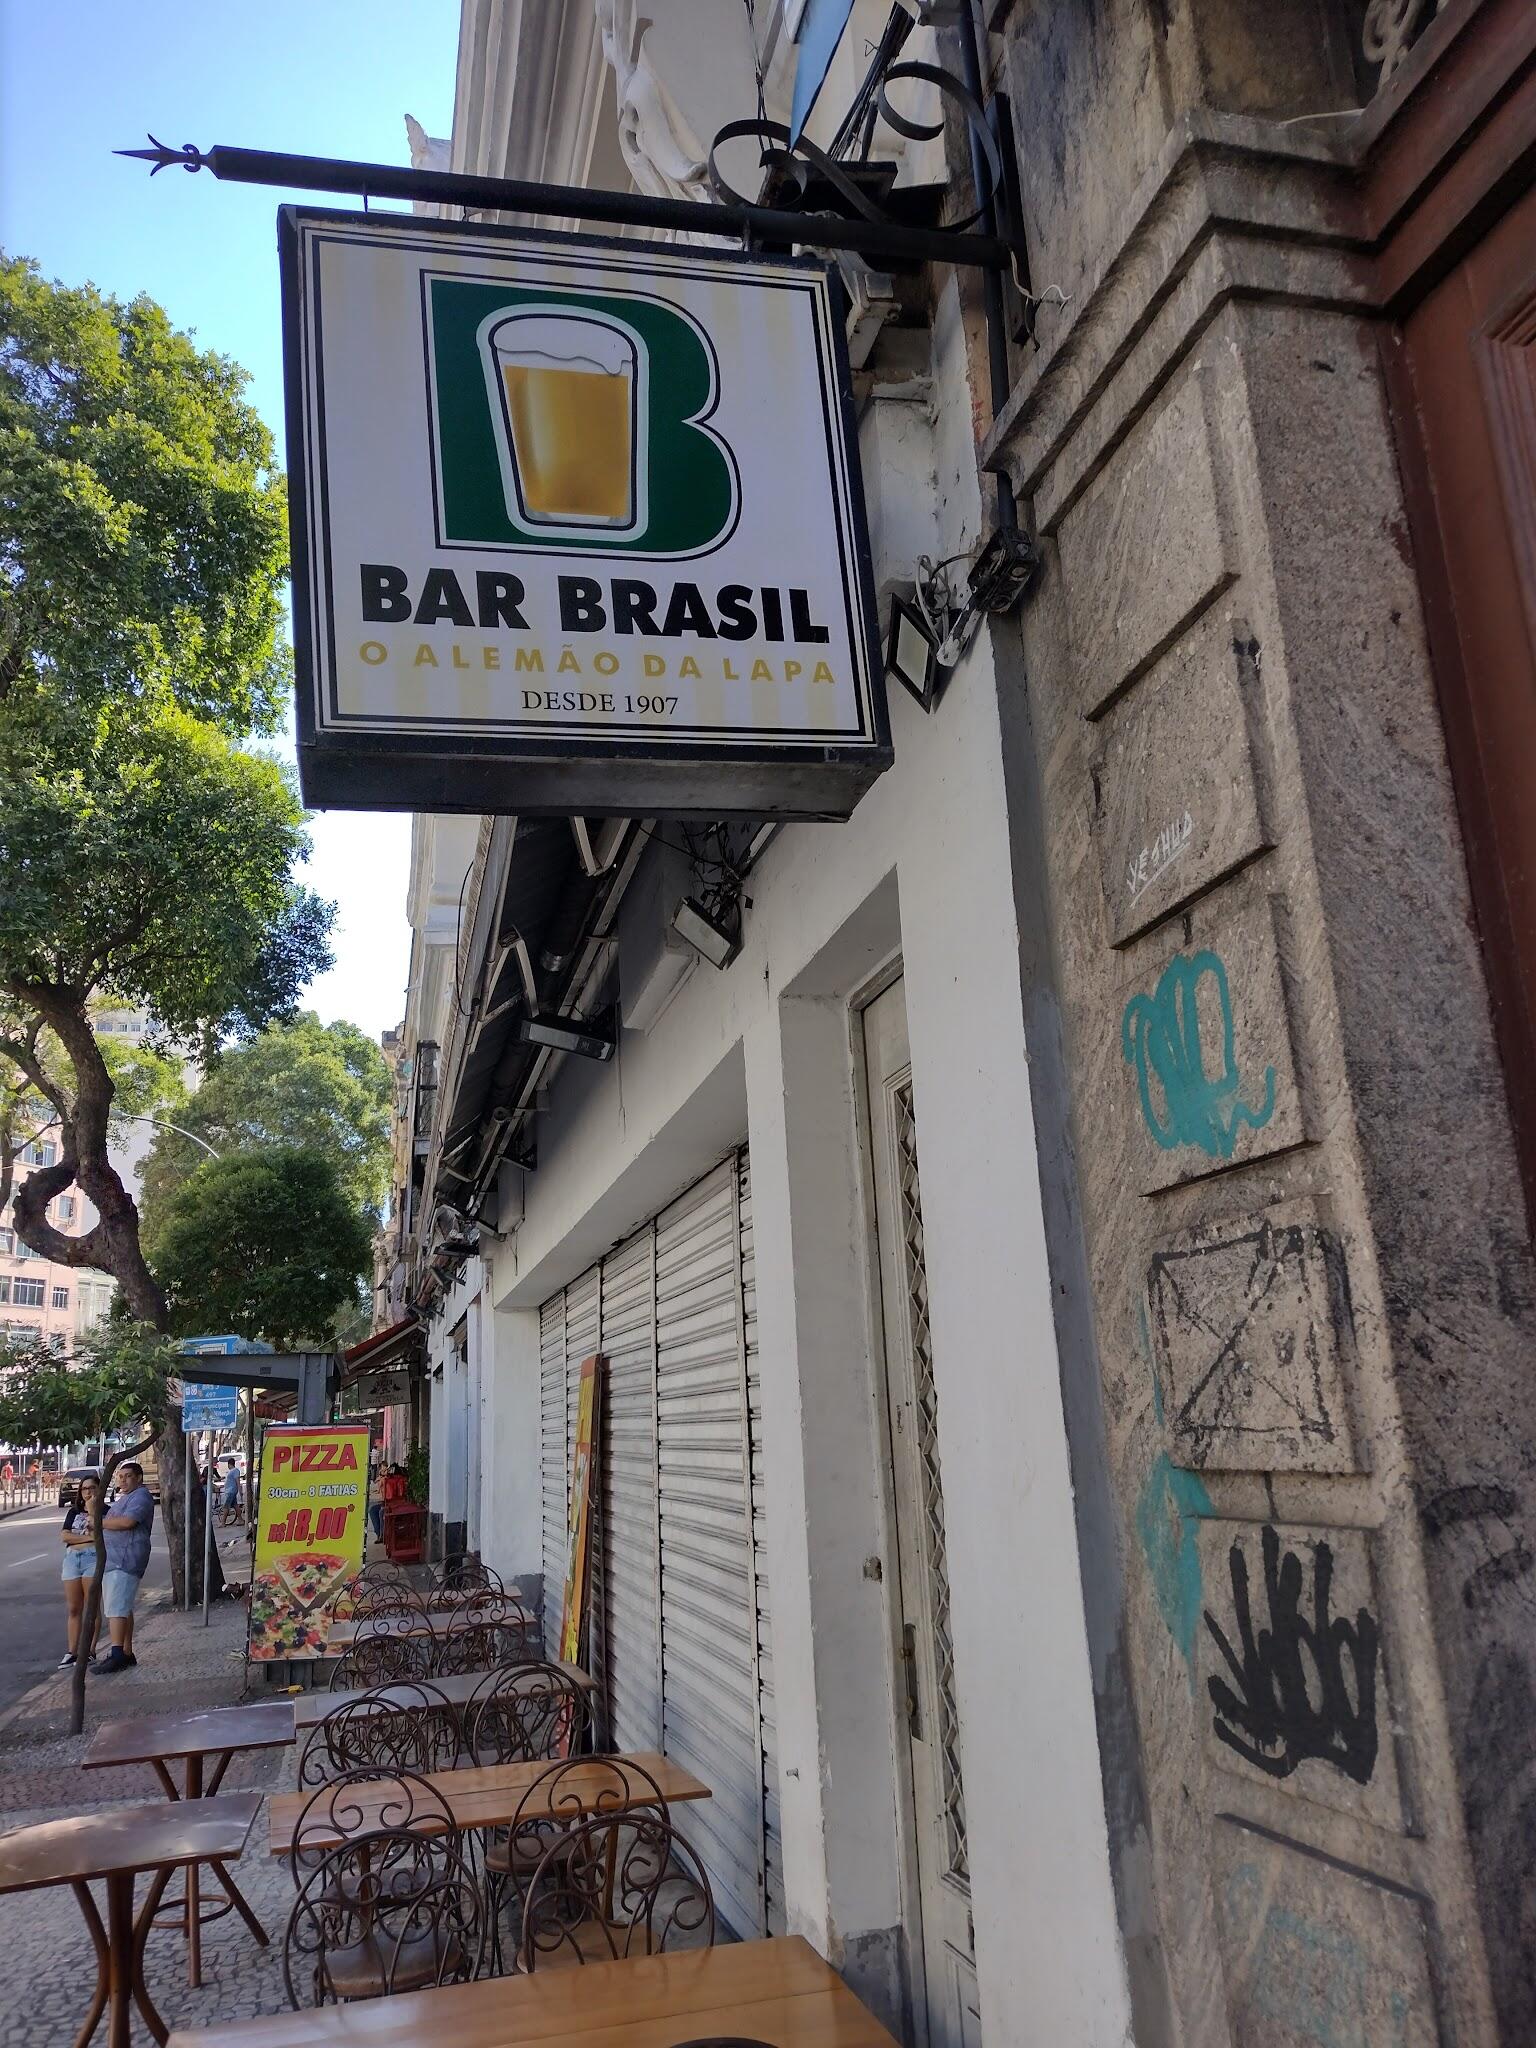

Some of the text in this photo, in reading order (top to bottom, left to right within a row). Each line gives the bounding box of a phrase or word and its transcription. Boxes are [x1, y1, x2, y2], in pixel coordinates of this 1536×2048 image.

[359, 563, 831, 644] BAR BRASIL
[359, 640, 835, 684] O ALEMÃO DA LAPA
[521, 689, 679, 716] DESDE 1907
[273, 1443, 358, 1473] PIZZA
[268, 1486, 299, 1499] 30cm
[308, 1485, 317, 1498] 8
[318, 1483, 359, 1497] FATIAS
